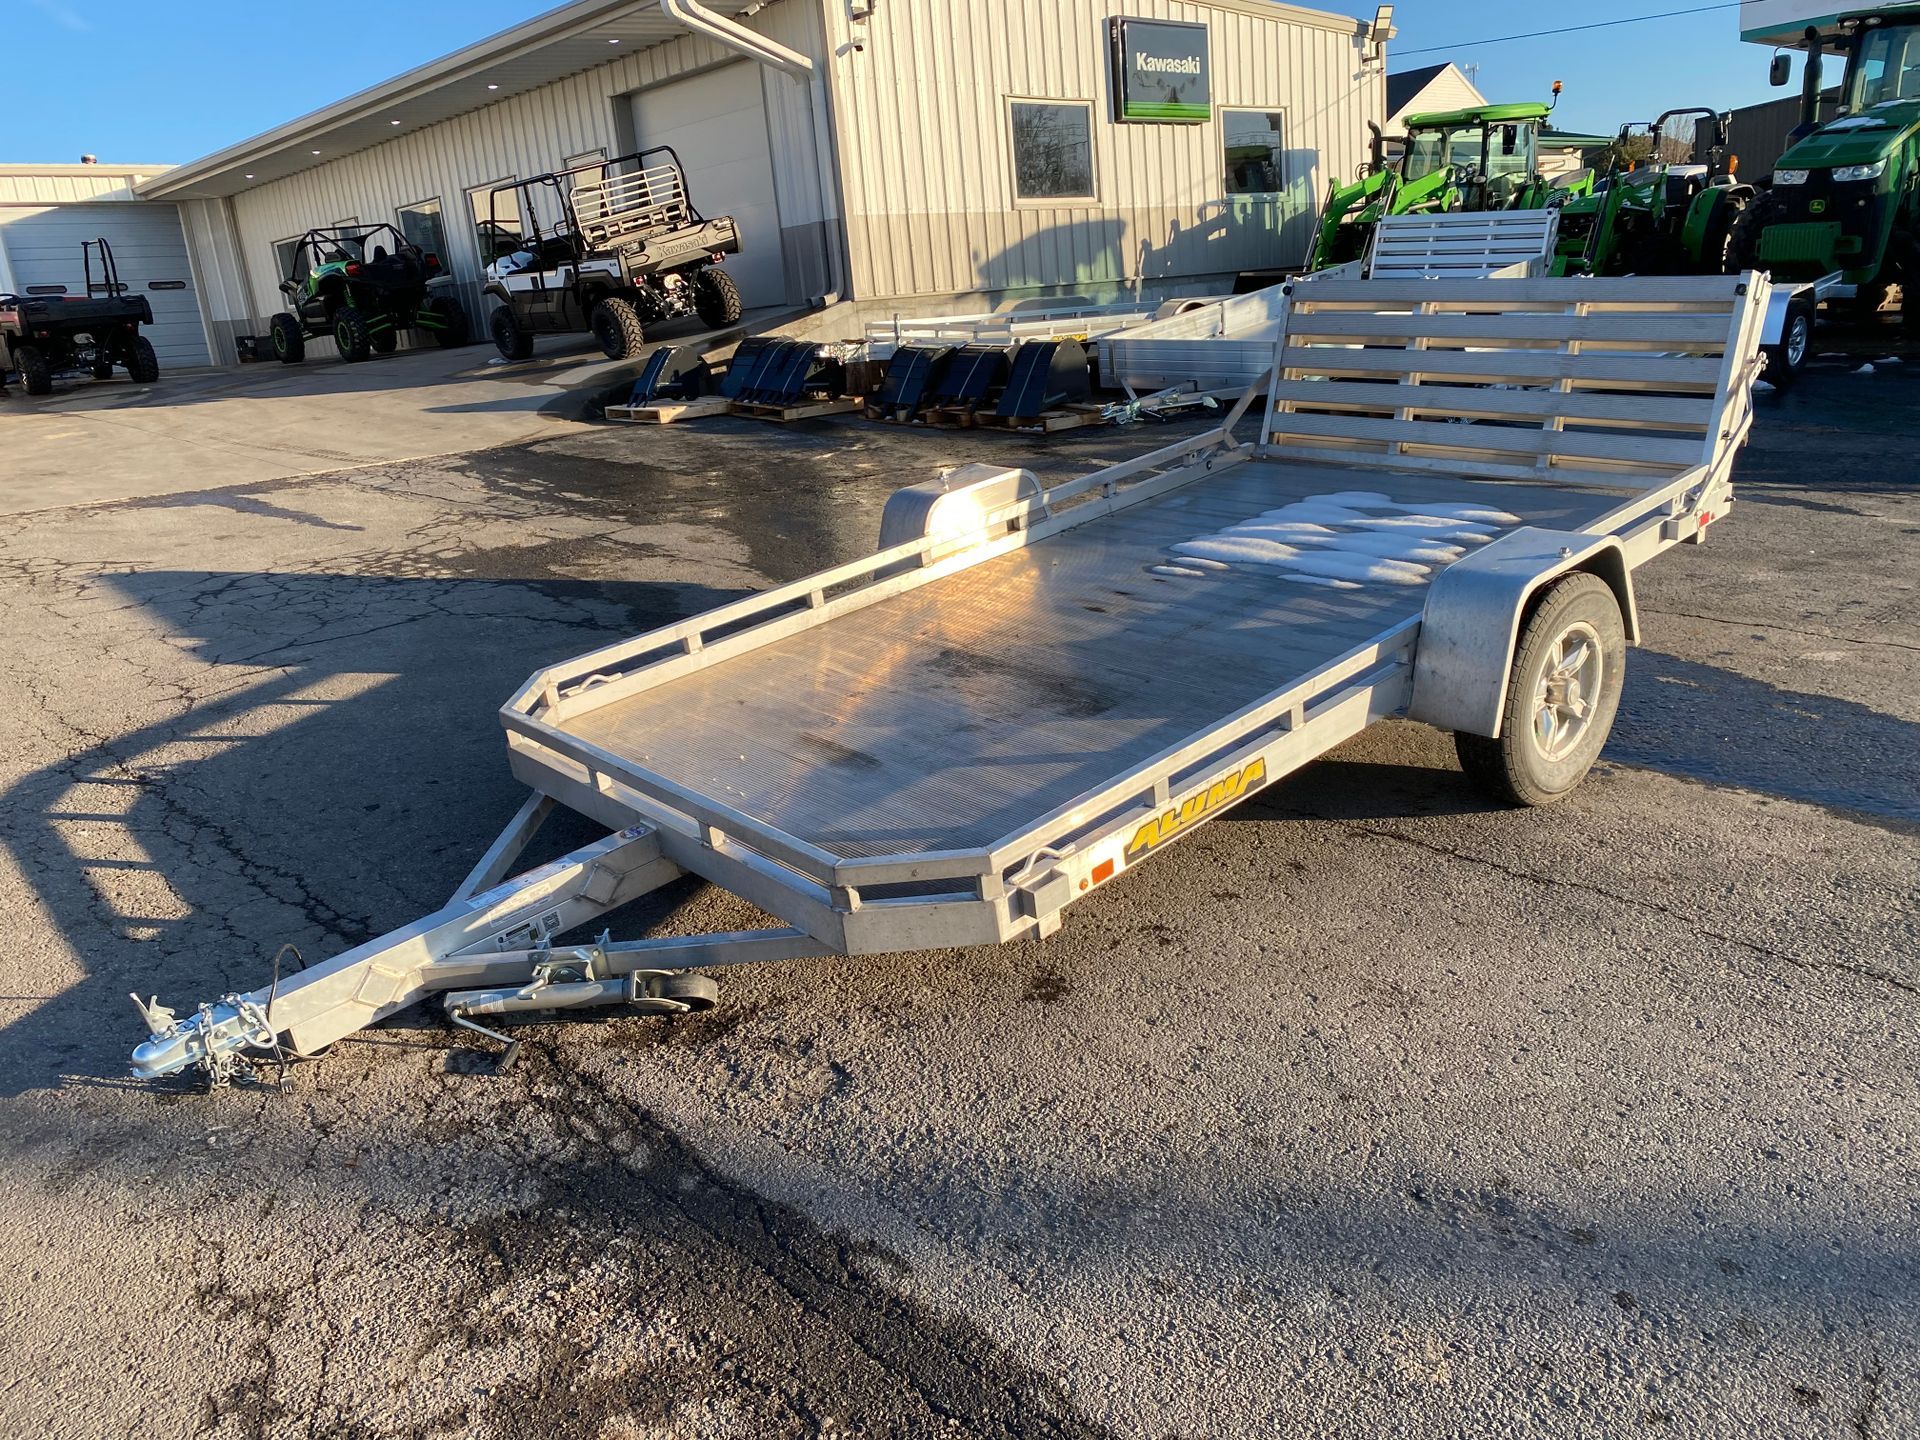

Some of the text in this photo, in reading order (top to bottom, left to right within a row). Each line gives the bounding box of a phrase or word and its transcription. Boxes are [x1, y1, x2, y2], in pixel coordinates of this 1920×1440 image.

[1136, 52, 1200, 74] Kawasaki
[657, 234, 708, 257] Kawasaki
[1128, 757, 1266, 855] ALUMA
